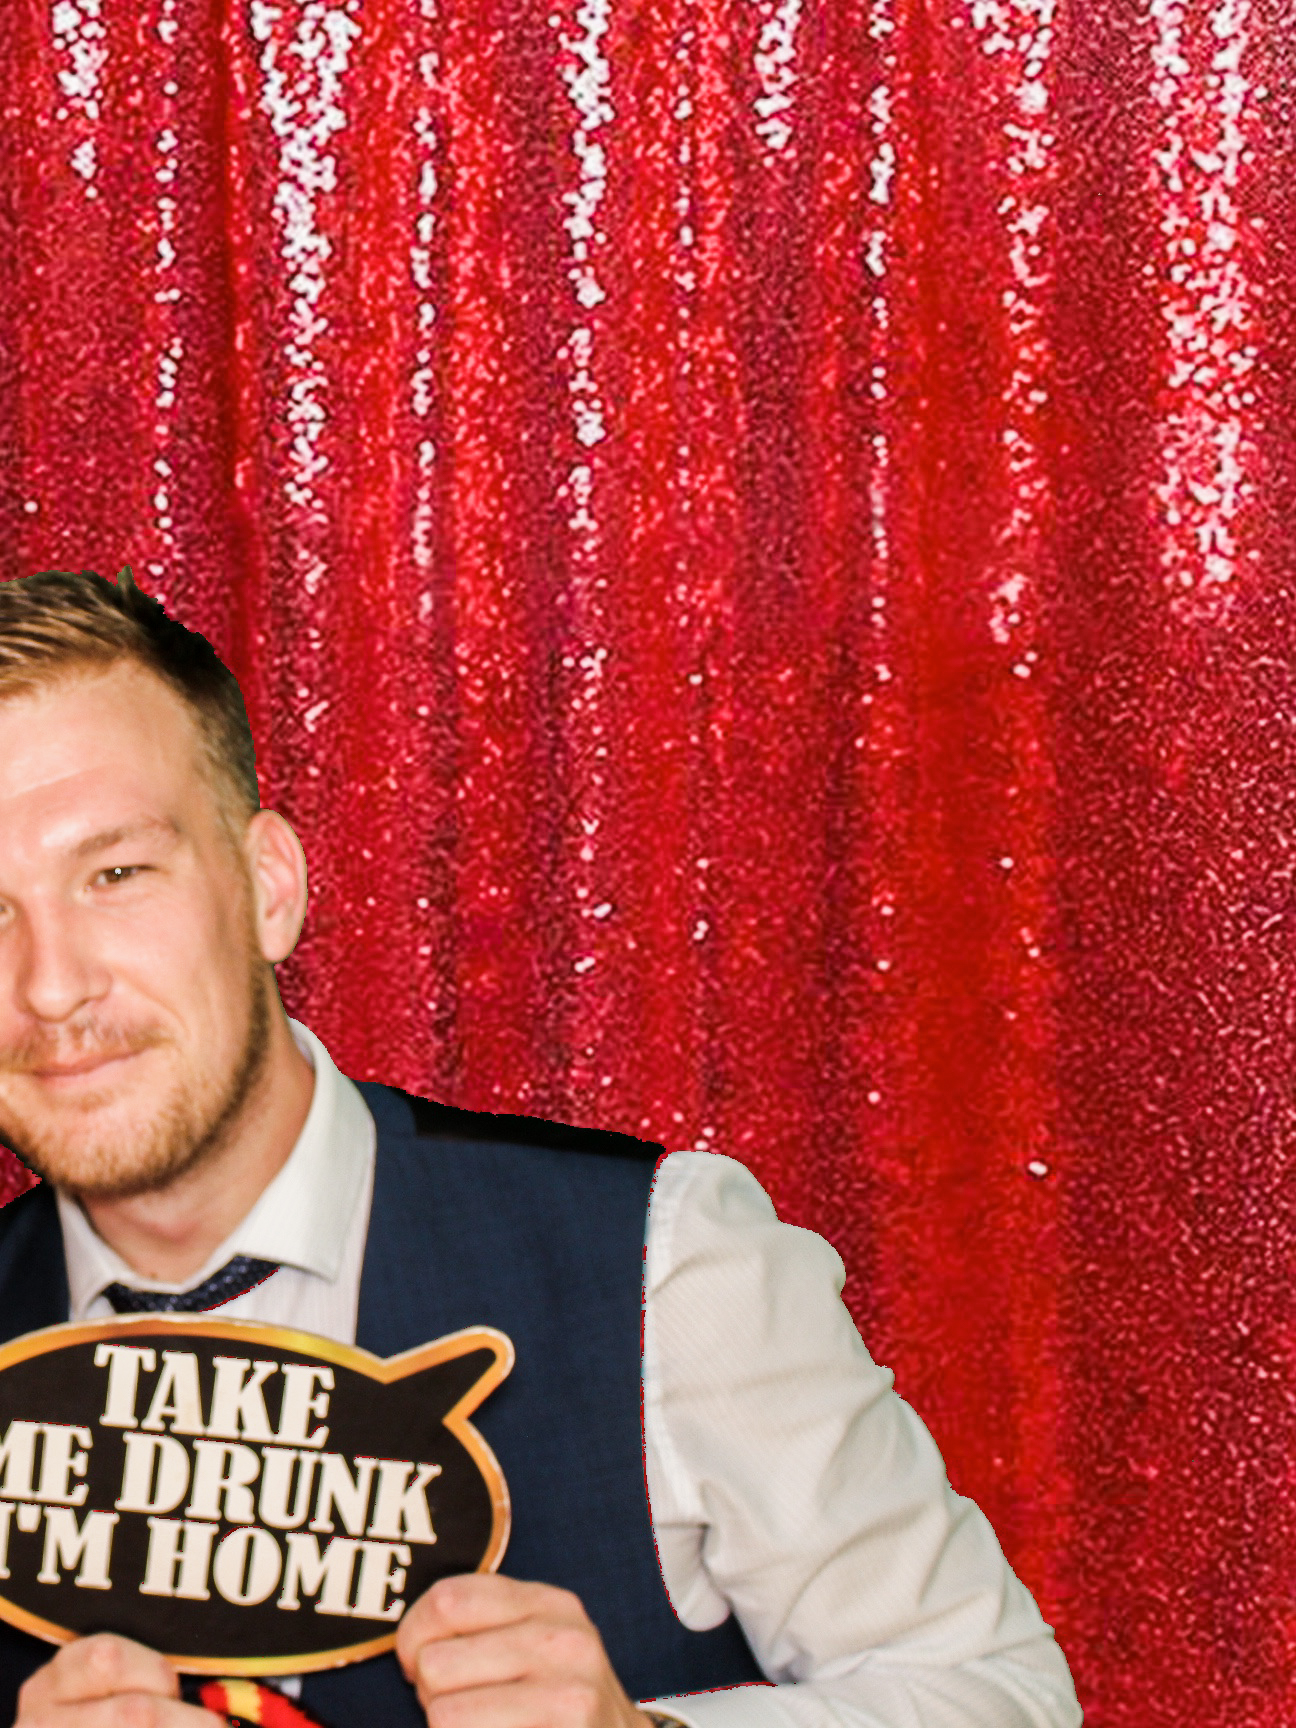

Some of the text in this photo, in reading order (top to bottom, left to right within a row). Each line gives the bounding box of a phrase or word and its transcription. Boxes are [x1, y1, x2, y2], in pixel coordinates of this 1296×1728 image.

[94, 1343, 335, 1449] TAKE
[114, 1431, 442, 1544] DRUNK
[139, 1516, 412, 1622] HOME
